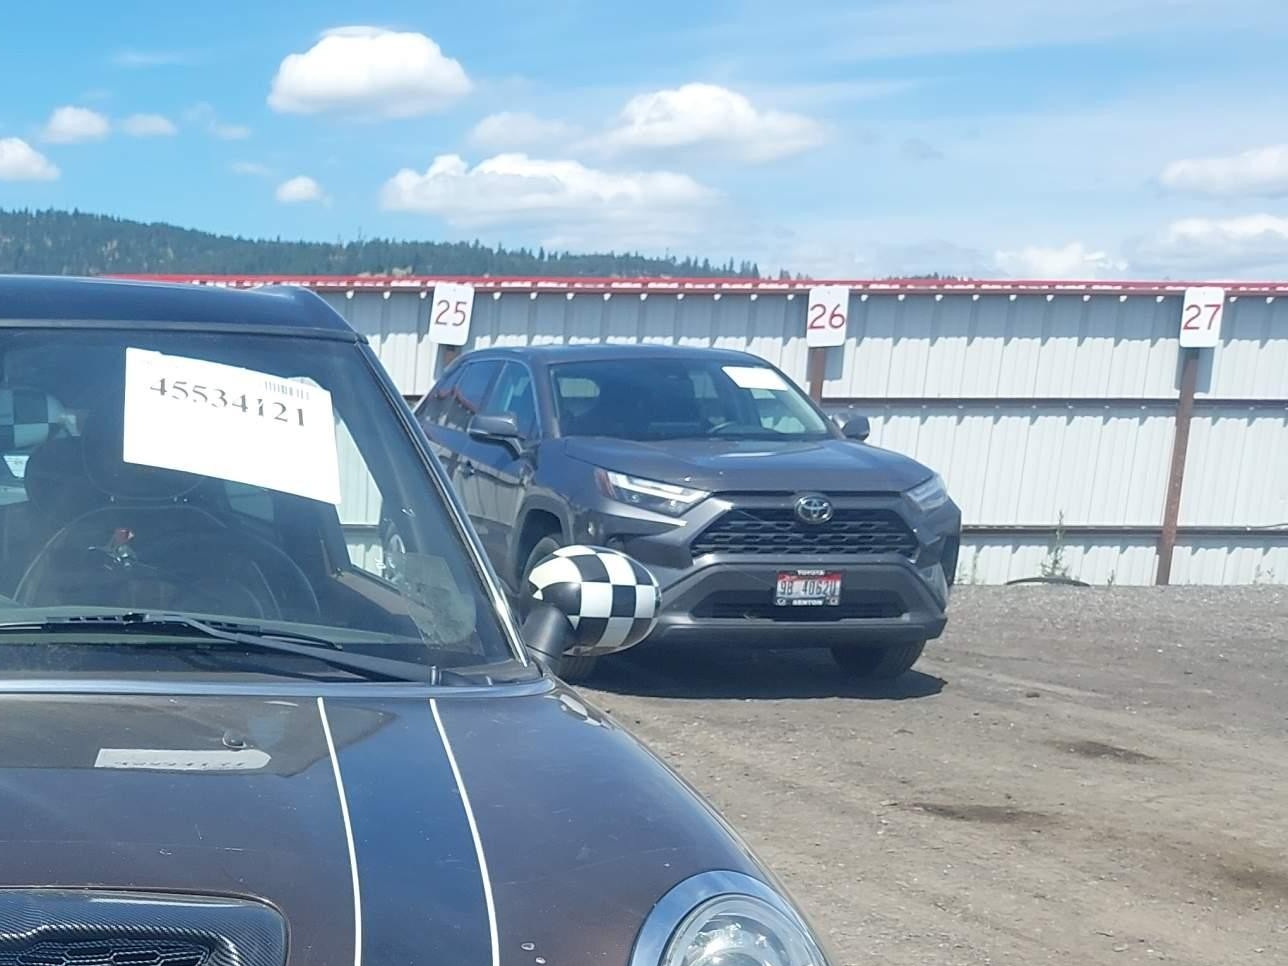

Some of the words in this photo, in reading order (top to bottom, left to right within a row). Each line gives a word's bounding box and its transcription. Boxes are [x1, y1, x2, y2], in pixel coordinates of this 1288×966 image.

[435, 299, 467, 327] 25
[808, 303, 845, 329] 26
[1183, 303, 1222, 330] 27
[150, 377, 305, 427] 45534121
